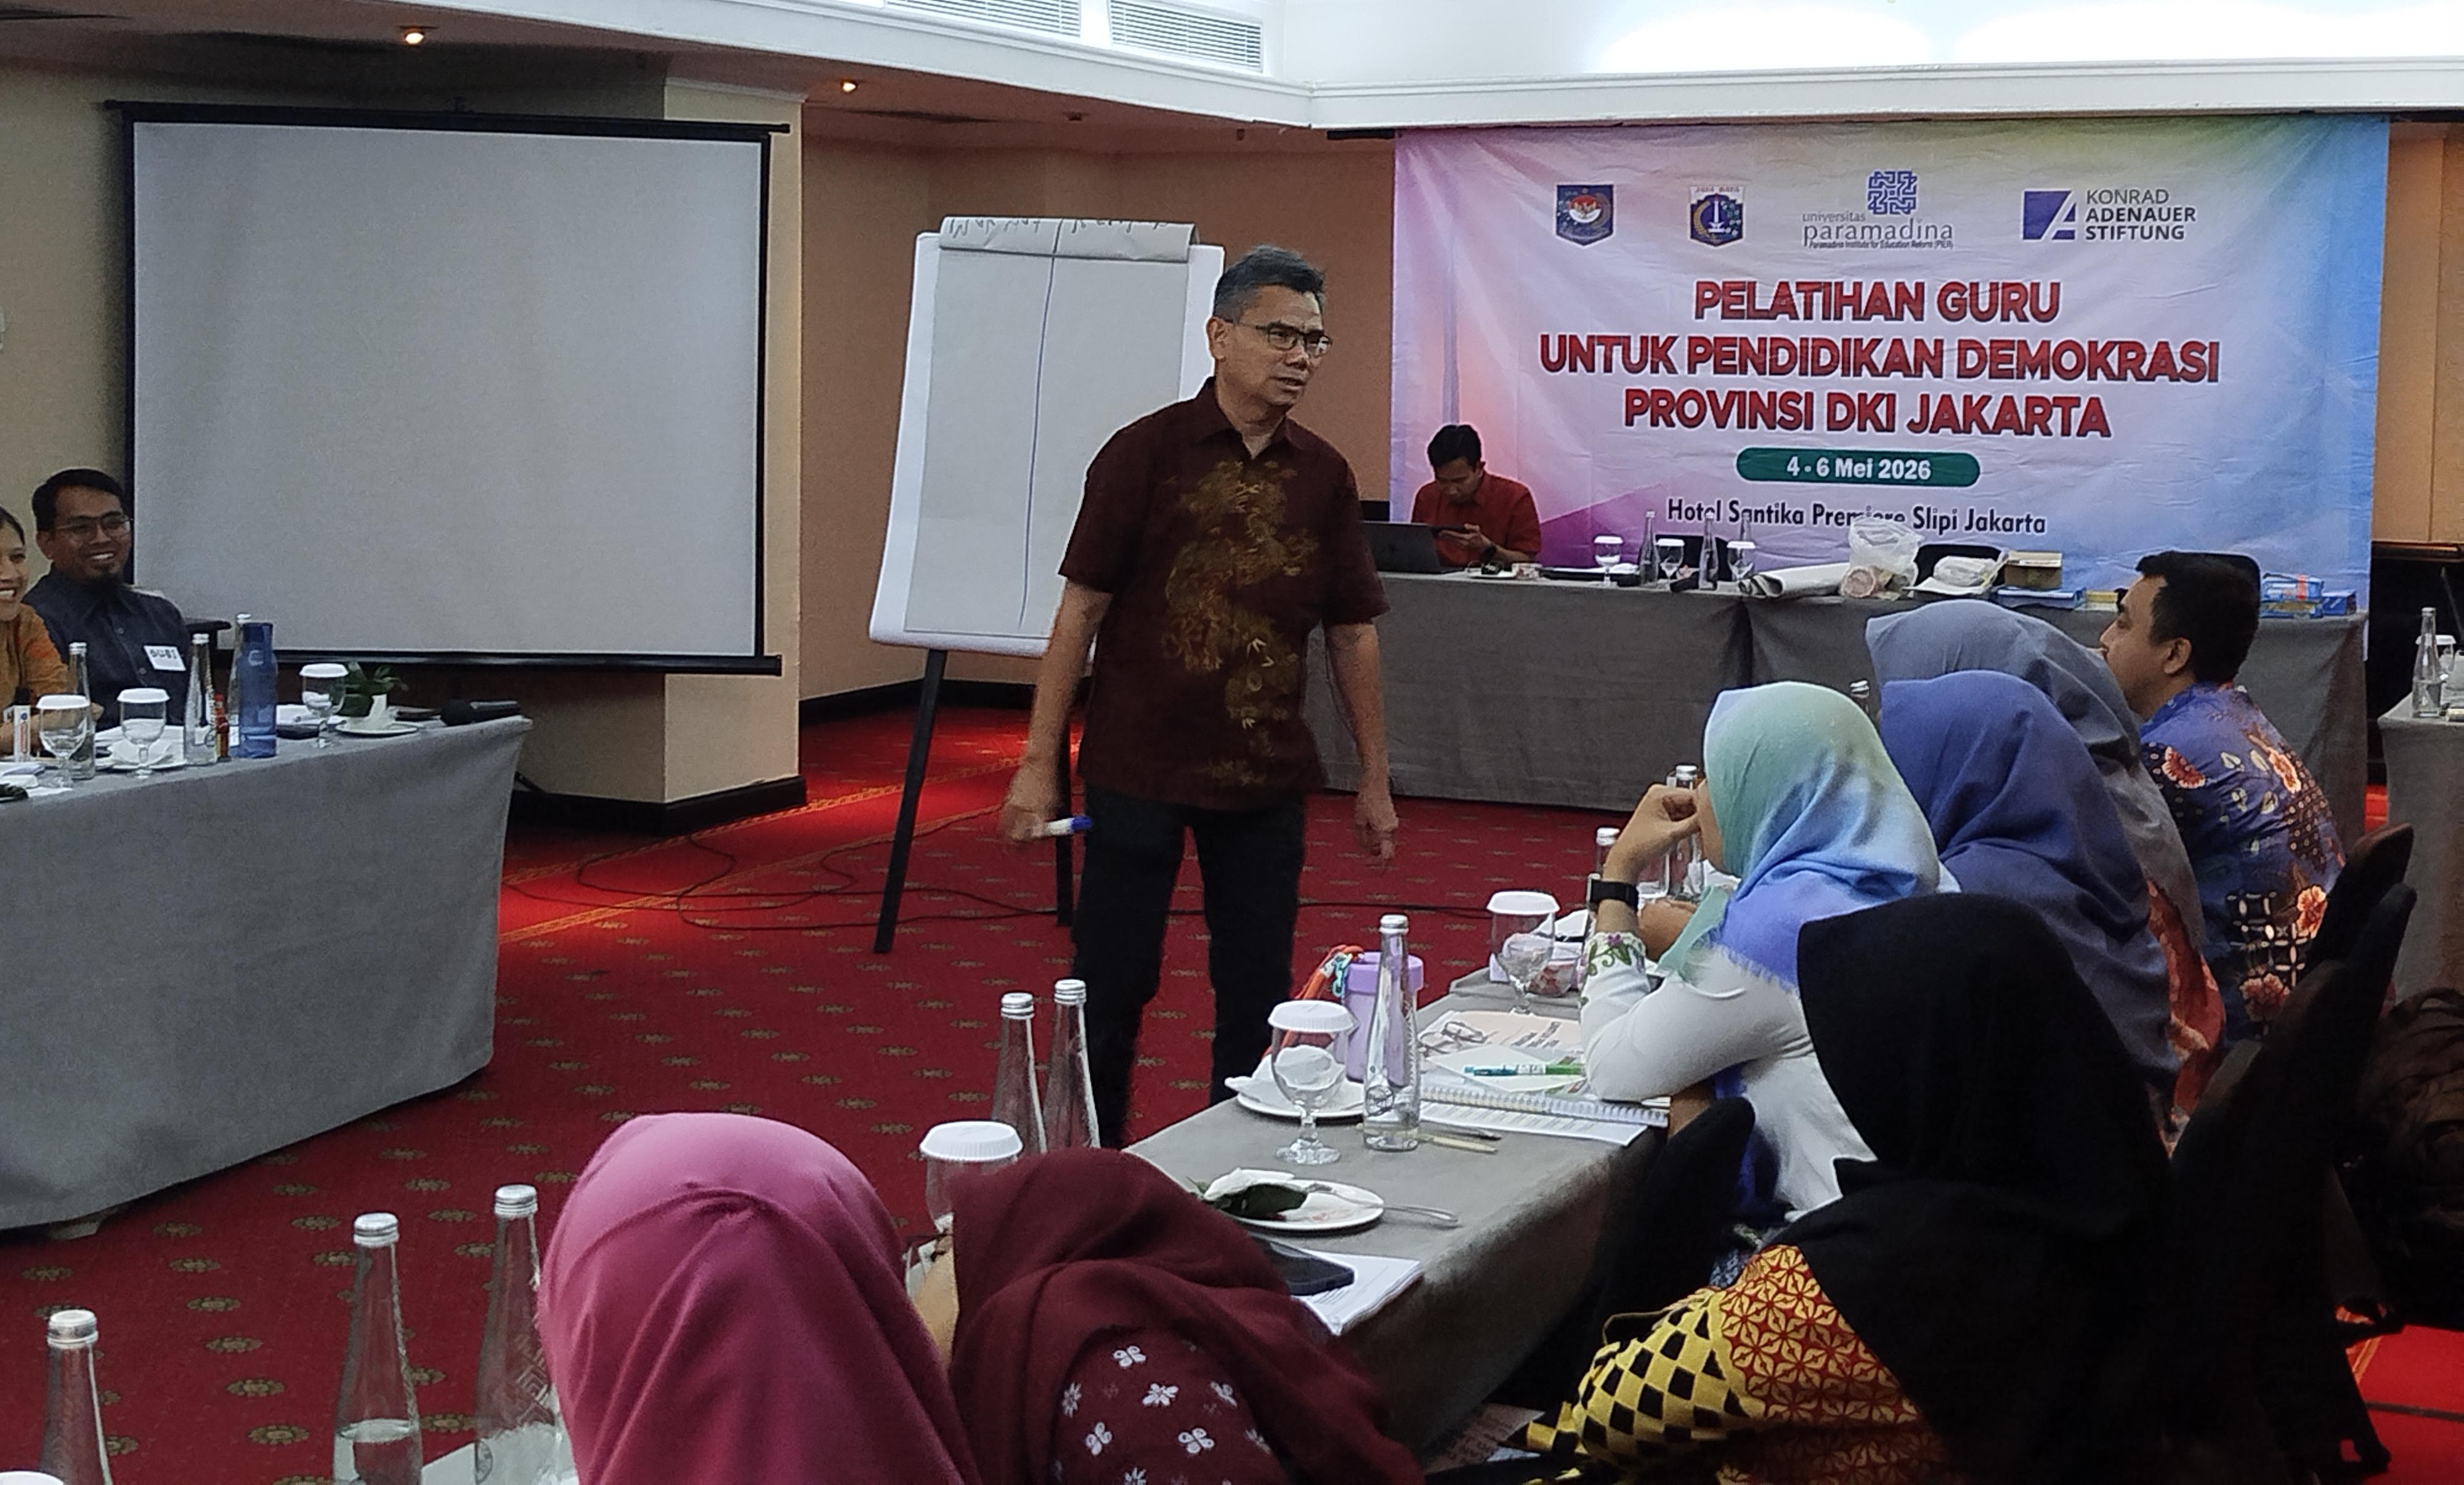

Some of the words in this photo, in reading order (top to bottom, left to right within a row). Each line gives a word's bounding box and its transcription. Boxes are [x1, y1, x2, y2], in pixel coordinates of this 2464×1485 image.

[2087, 189, 2170, 205] KONRAD
[1802, 210, 1866, 222] universitas
[2085, 207, 2196, 222] ADENAUER
[1804, 218, 1952, 246] paramadina
[2085, 225, 2185, 240] STIFTUNG
[1694, 281, 1924, 321] PELATIHAN
[1937, 282, 2061, 323] GURU
[1540, 334, 1679, 374] UNTUK
[1687, 336, 1944, 378] PENDIDIKAN
[1956, 339, 2220, 383] DEMOKRASI
[1624, 388, 1814, 431] PROVINSI
[1826, 392, 1896, 433] DKI
[1907, 393, 2112, 438] JAKARTA
[1787, 456, 1800, 476] 4
[1816, 457, 1830, 477] 6
[1834, 458, 1873, 478] Mei
[1878, 459, 1931, 480] 2026
[1729, 500, 1804, 524] Santika
[1913, 506, 1957, 535] Slipi
[1964, 508, 2046, 533] Jakarta
